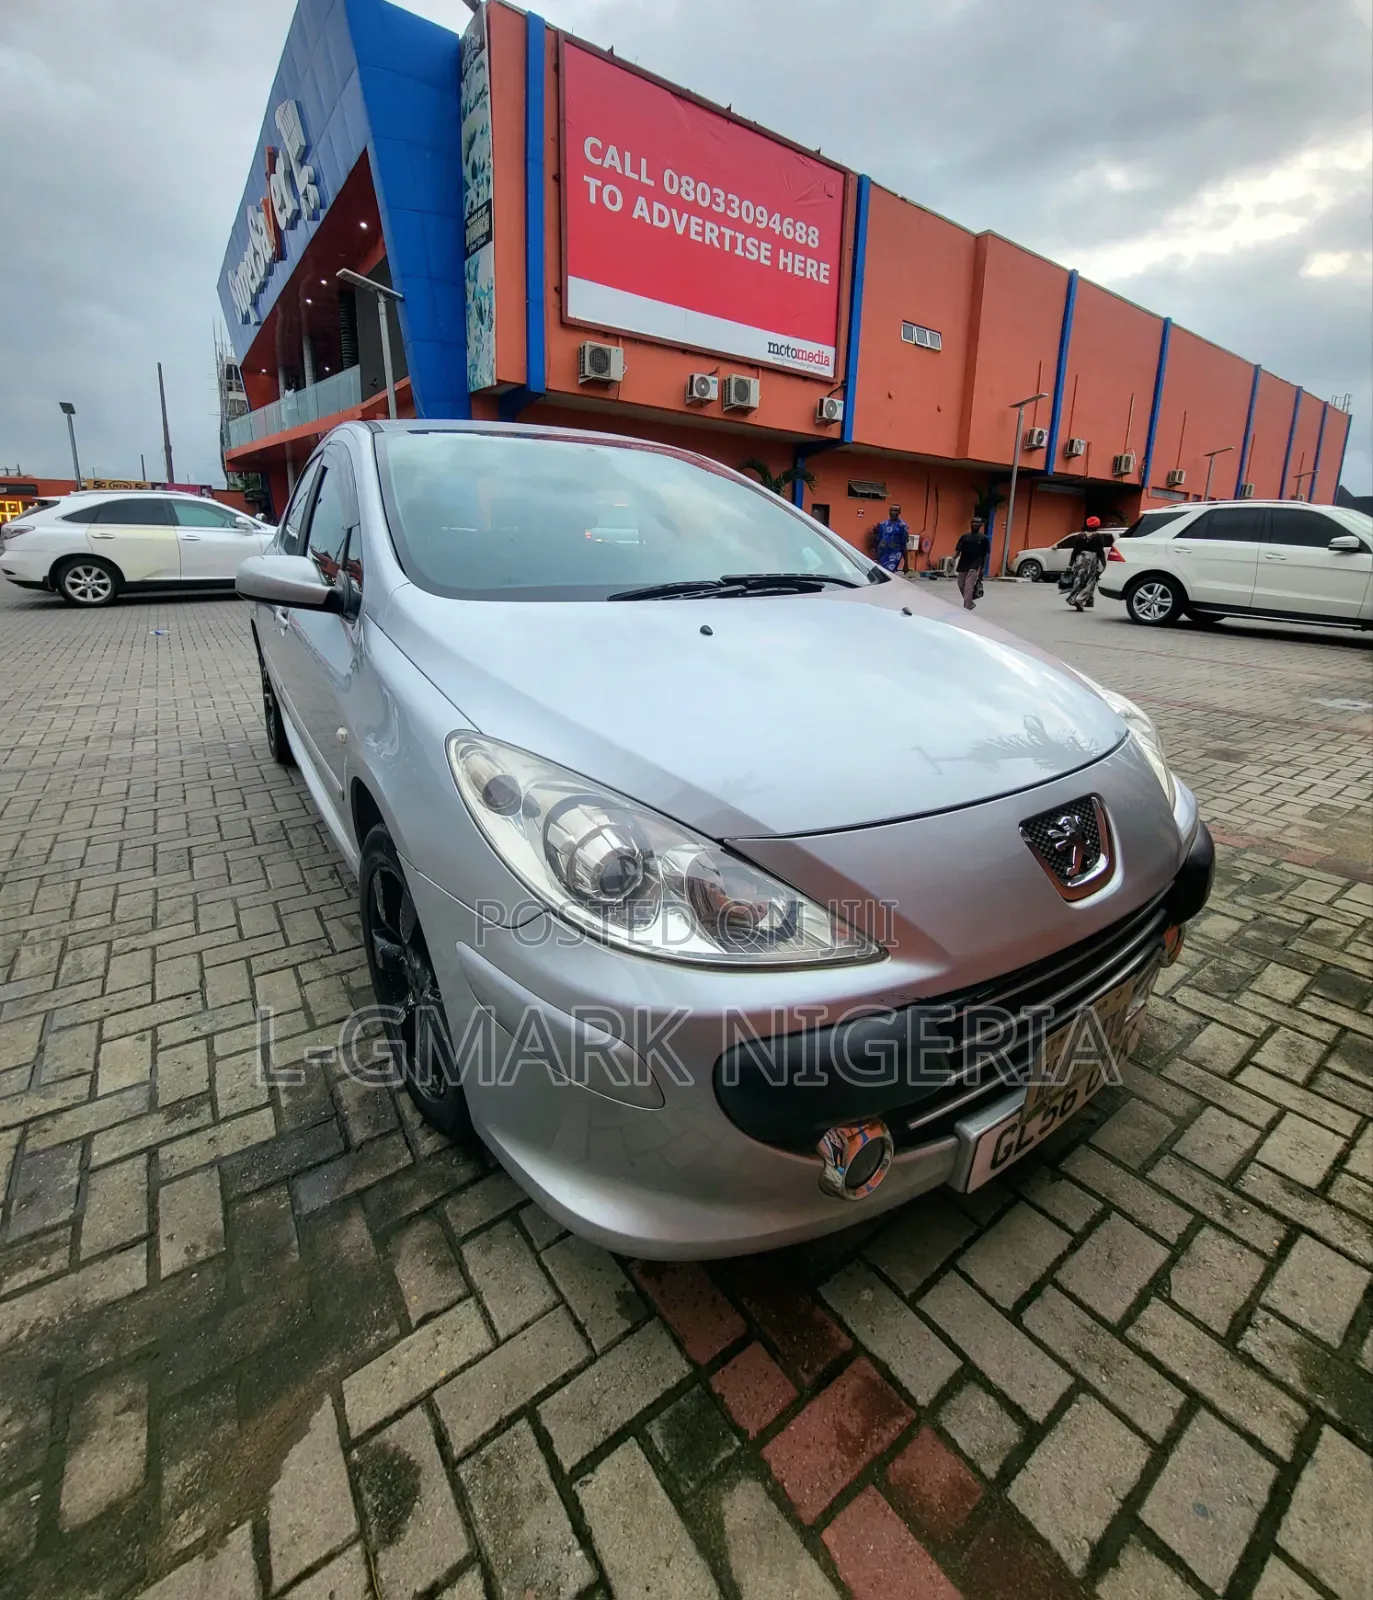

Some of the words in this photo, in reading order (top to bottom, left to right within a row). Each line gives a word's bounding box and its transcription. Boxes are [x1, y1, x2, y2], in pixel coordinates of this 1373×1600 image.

[583, 136, 655, 186] CALL
[663, 168, 820, 249] 08033094688
[583, 175, 624, 212] TO
[632, 196, 772, 266] ADVERTISE
[778, 248, 831, 284] HERE
[767, 341, 831, 367] motomedia
